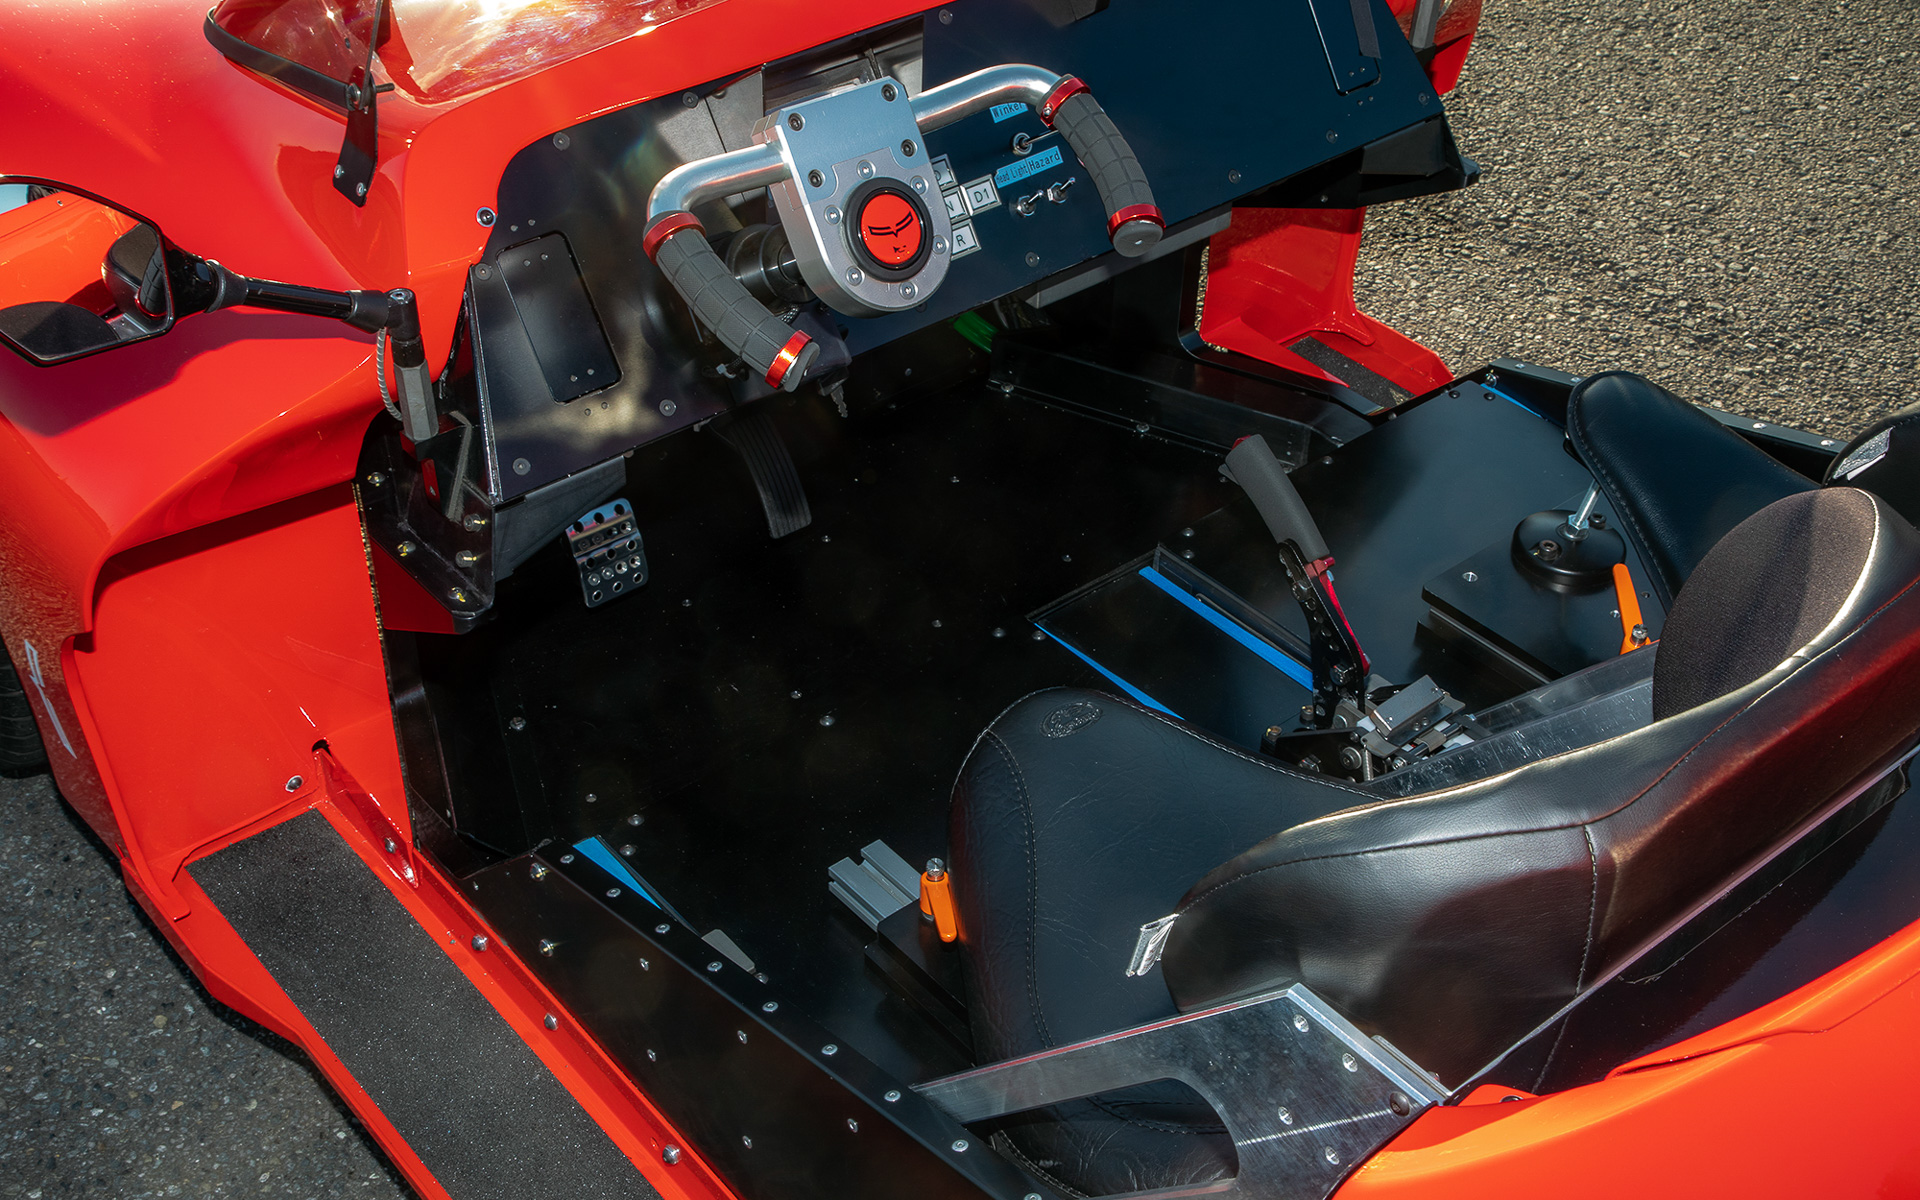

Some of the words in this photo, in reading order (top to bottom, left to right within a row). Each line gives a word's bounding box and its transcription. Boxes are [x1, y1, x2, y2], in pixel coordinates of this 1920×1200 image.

[1028, 150, 1060, 171] Hazard
[1009, 164, 1029, 178] Light
[973, 188, 990, 203] D1
[955, 234, 966, 247] R
